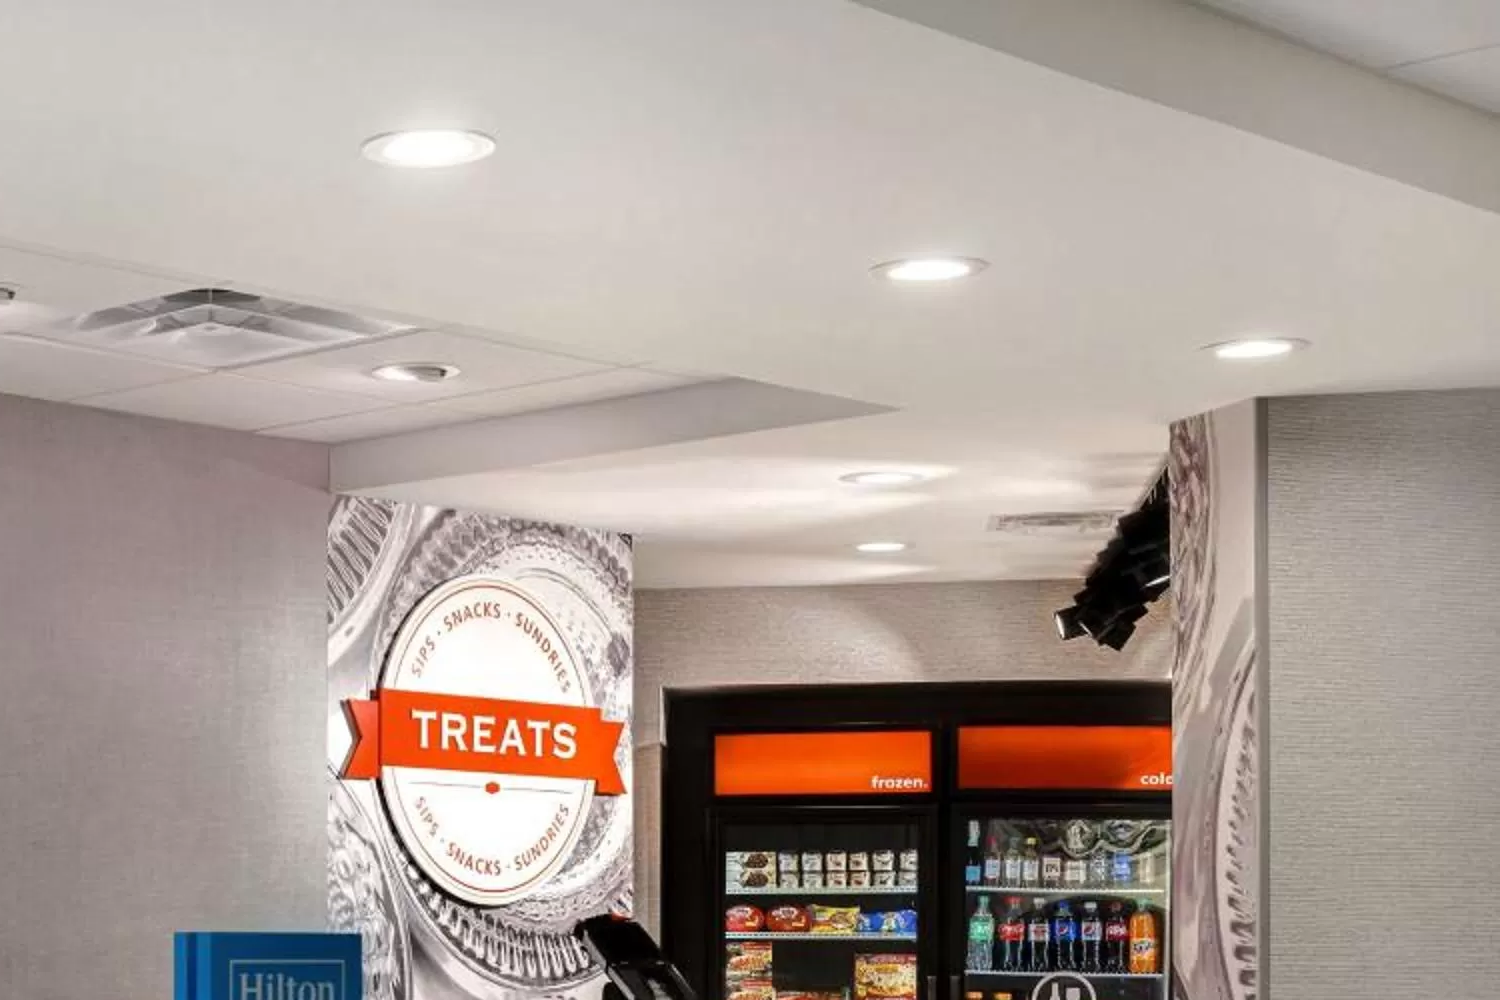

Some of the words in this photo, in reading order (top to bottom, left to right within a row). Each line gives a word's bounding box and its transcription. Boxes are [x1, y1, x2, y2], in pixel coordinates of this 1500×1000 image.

[412, 636, 435, 677] SIPS
[443, 601, 501, 631] SNACKS
[515, 613, 571, 693] SUNDRIES
[411, 709, 577, 758] TREATS
[871, 775, 929, 790] frozen.
[415, 796, 438, 837] SIPS
[445, 841, 502, 877] SNACKS
[513, 803, 570, 871] SUNDRIES
